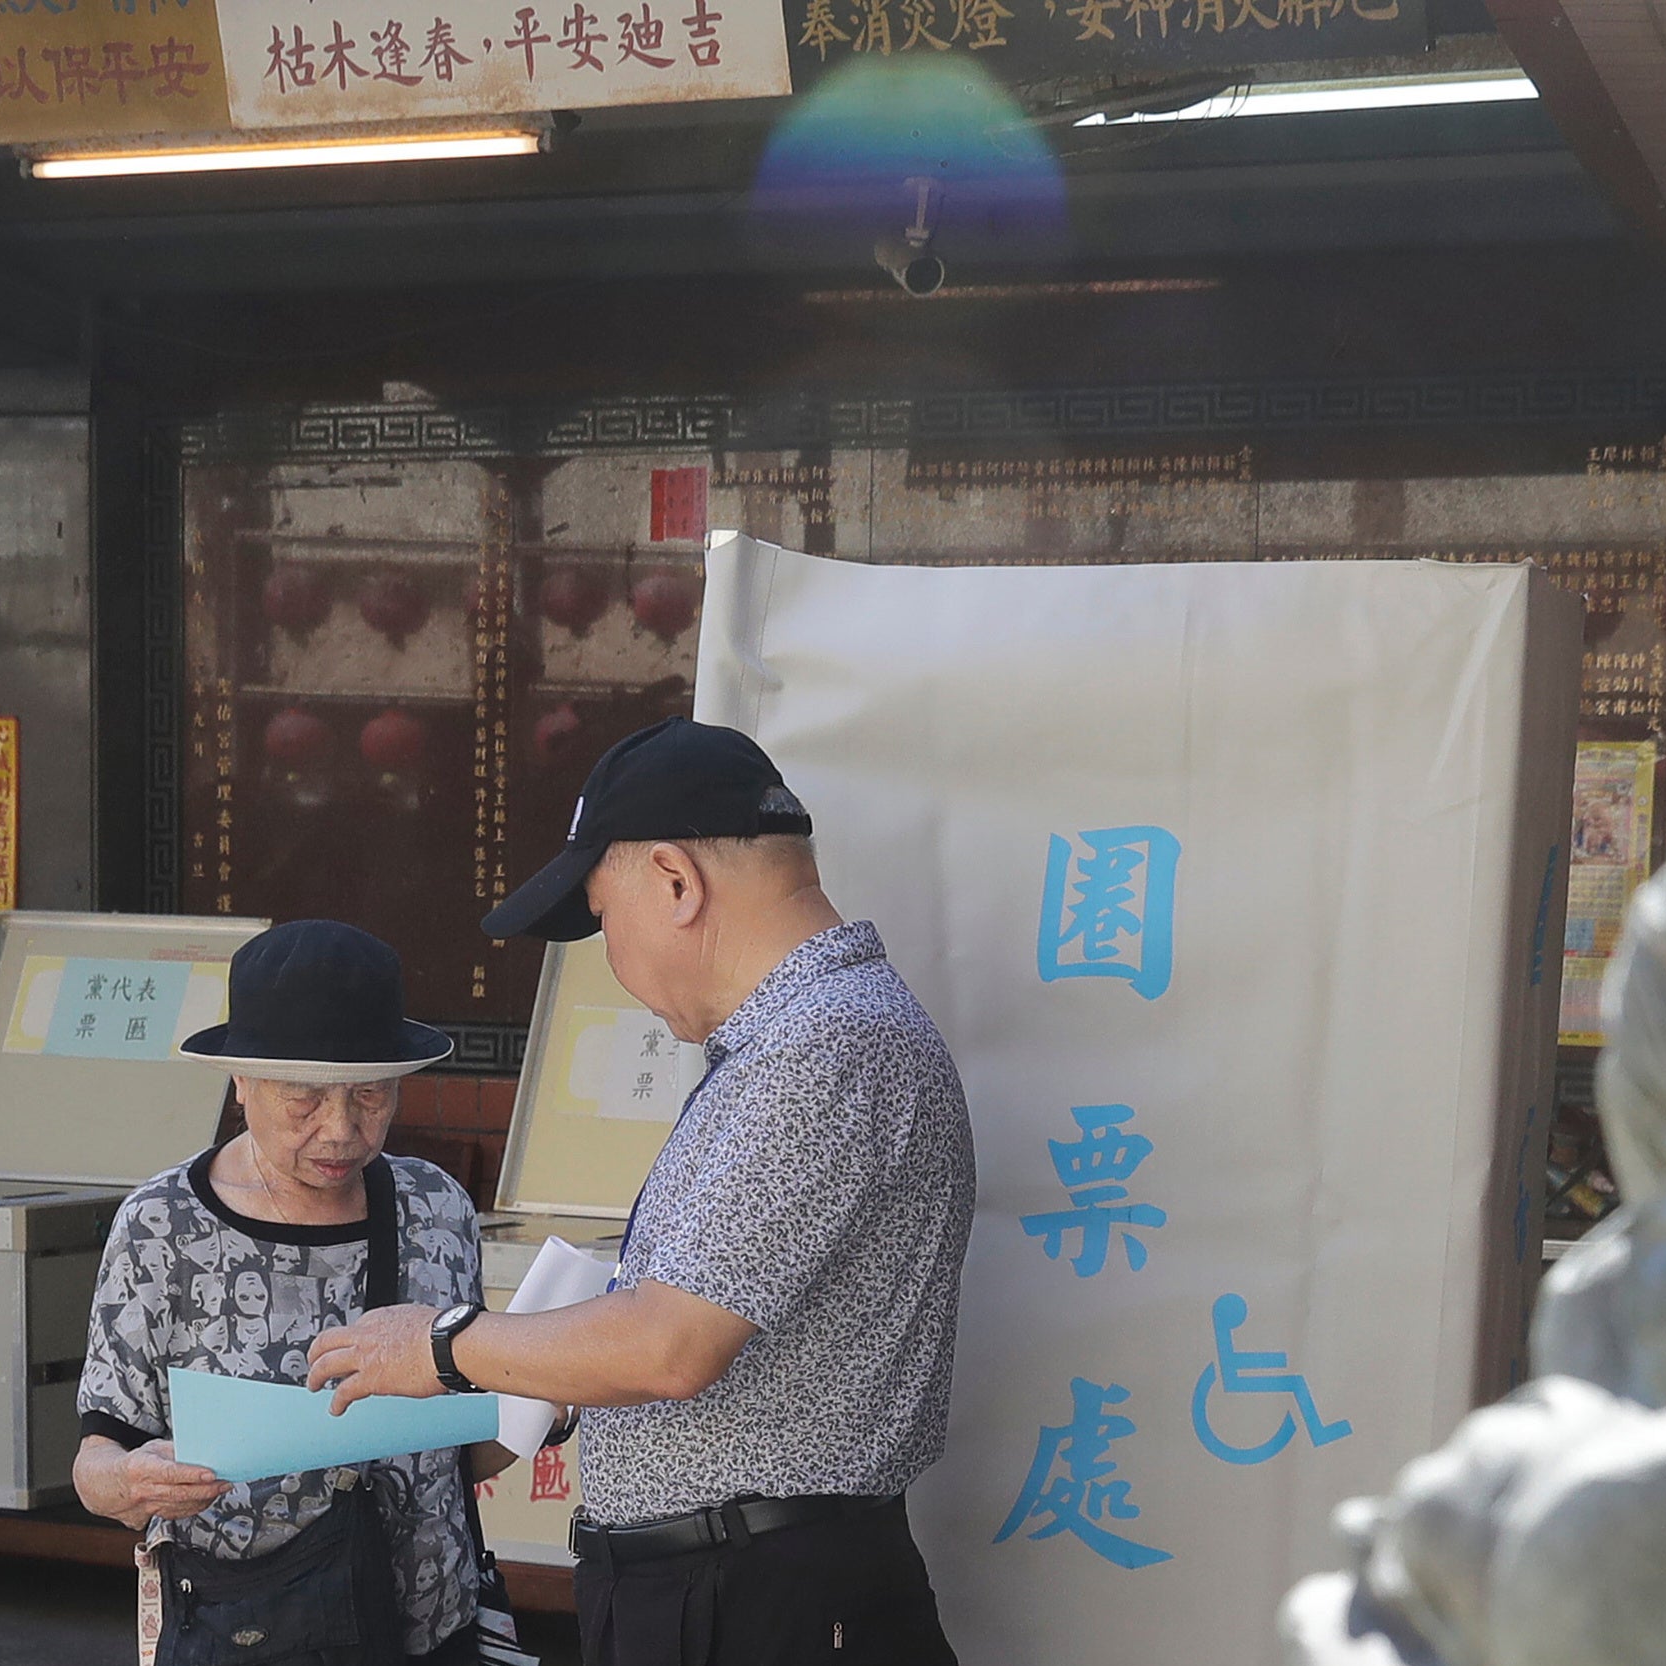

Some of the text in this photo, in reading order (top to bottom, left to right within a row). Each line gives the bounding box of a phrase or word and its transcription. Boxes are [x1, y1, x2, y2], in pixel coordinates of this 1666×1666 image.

[85, 973, 157, 1002] 黨代表
[991, 824, 1183, 1570] 圈票處
